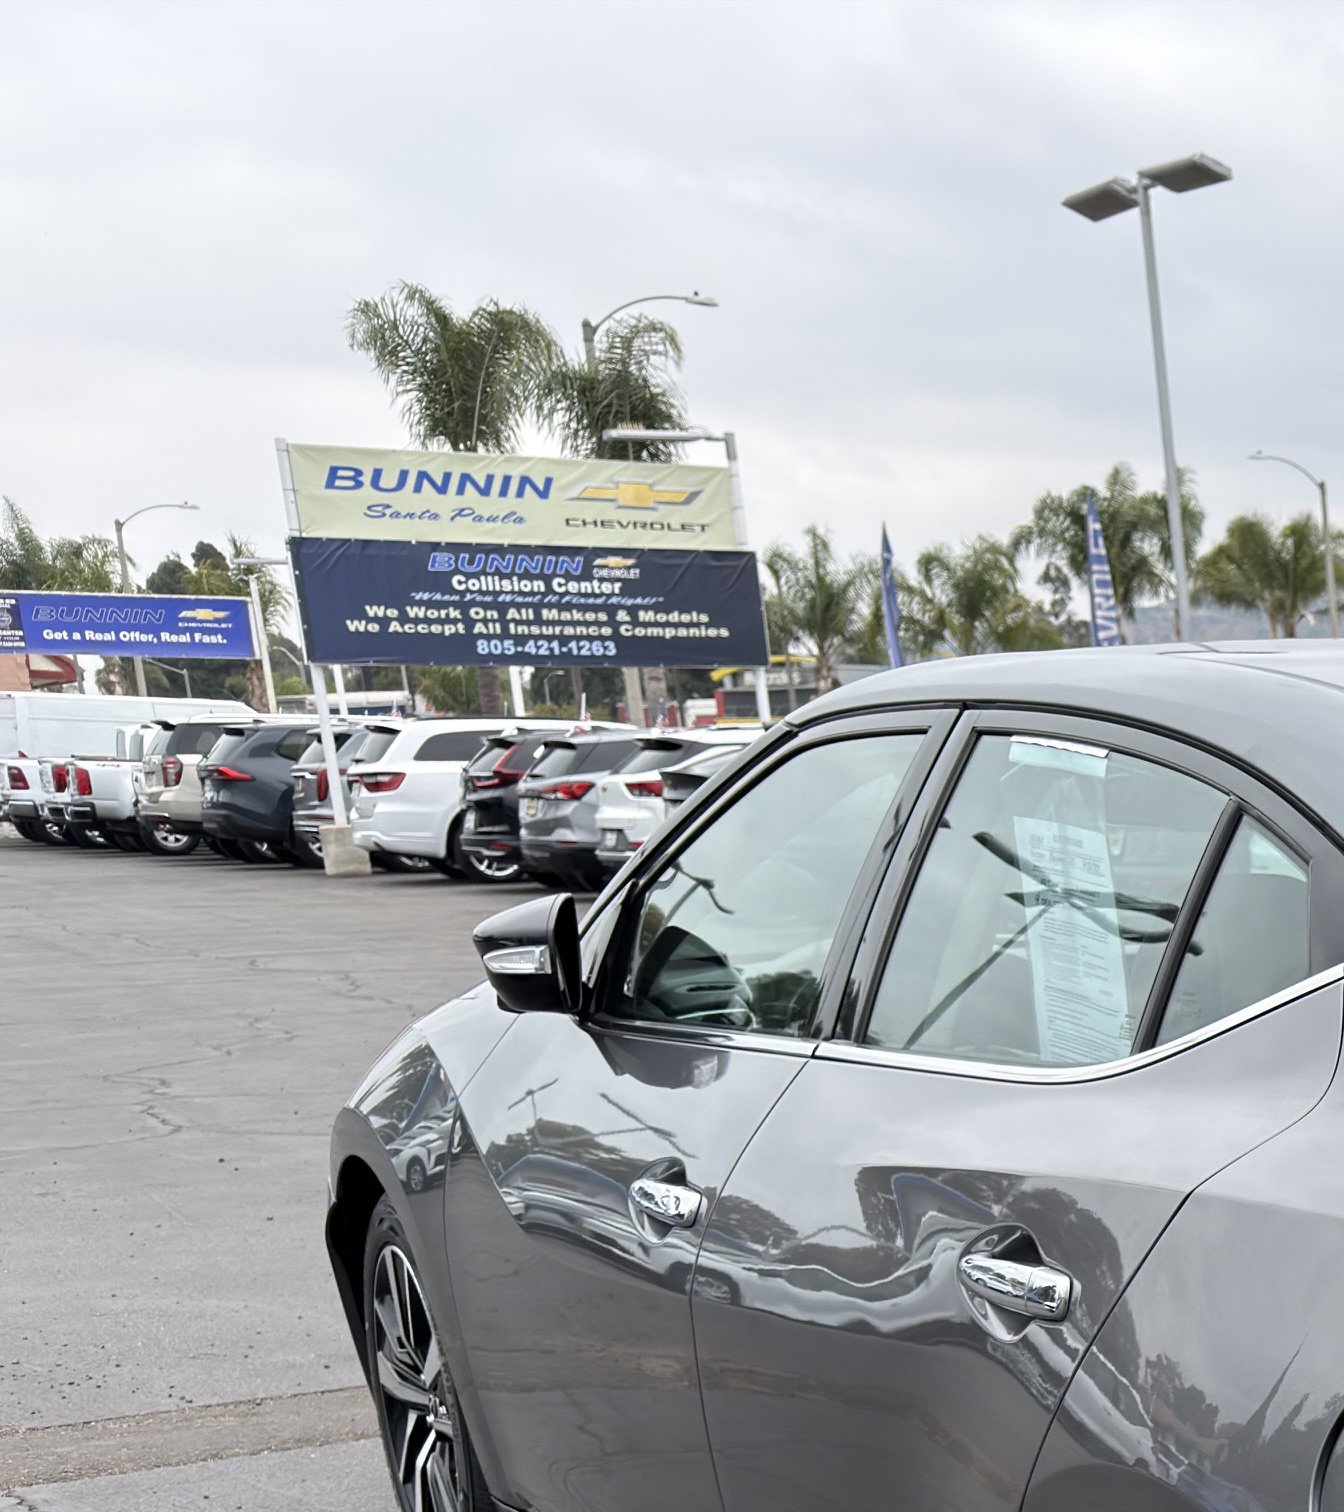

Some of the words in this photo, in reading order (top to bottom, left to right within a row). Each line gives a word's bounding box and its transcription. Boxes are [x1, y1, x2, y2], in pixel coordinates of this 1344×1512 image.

[324, 465, 554, 500] BUNNIN
[363, 503, 440, 521] Santa
[450, 507, 526, 525] Paula
[565, 517, 710, 533] CHEVROLET
[428, 552, 584, 575] BUNNIN
[593, 567, 640, 579] CHEVROLET
[451, 575, 546, 593] Collision
[552, 577, 622, 594] Center
[464, 593, 494, 602] You
[497, 593, 541, 602] Want
[32, 606, 165, 624] BUNNIN
[365, 605, 399, 618] We
[406, 606, 463, 619] Work
[469, 607, 499, 620] On
[506, 608, 534, 620] All
[541, 608, 608, 622] Makes
[616, 609, 631, 622] &
[638, 610, 709, 623] Models
[42, 629, 68, 640] Get
[72, 632, 81, 640] a
[85, 630, 116, 641] Real
[119, 630, 158, 644] Offer,
[160, 631, 191, 643] Real
[194, 633, 227, 644] Fast.
[346, 619, 380, 633] We
[388, 620, 466, 636] Accept
[473, 622, 501, 635] All
[509, 622, 613, 636] Insurance
[619, 624, 730, 639] Companies
[476, 639, 617, 656] 805-421-1263
